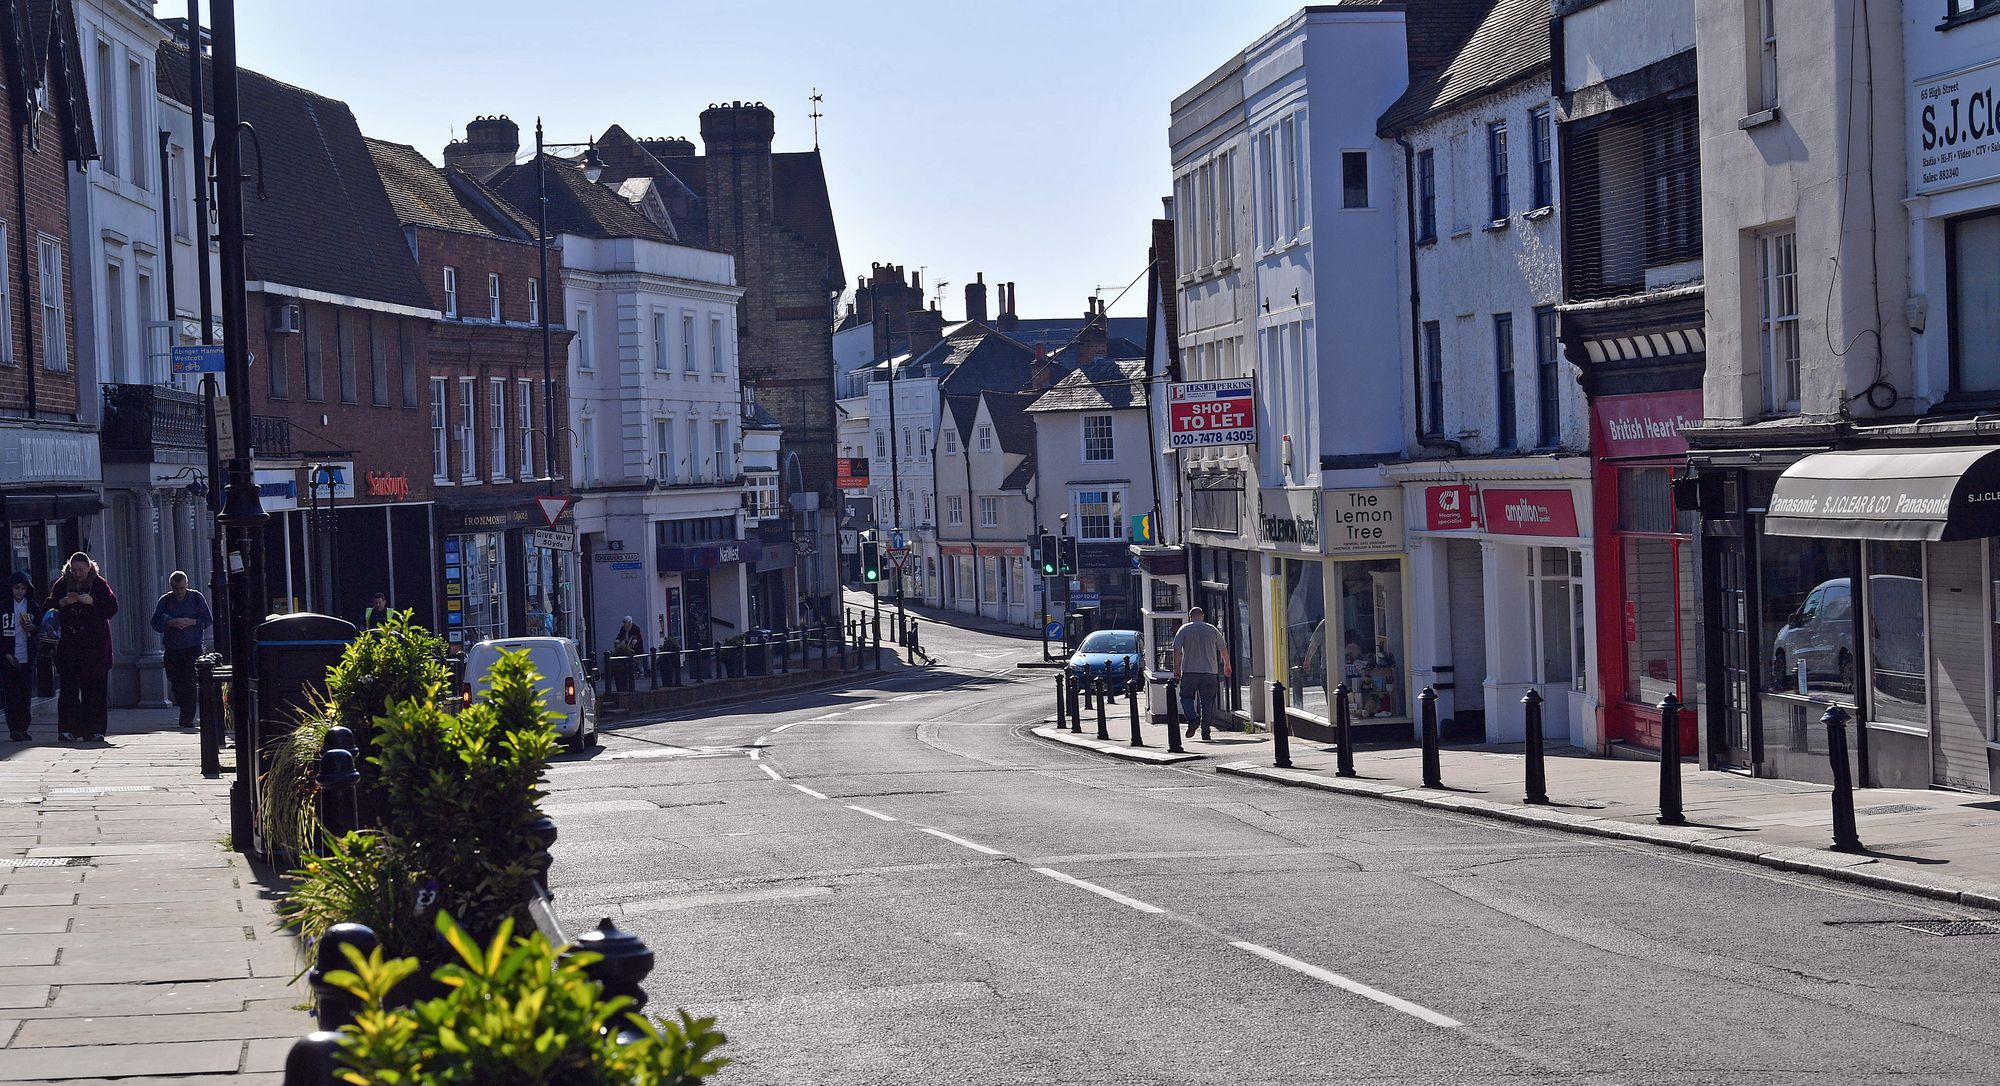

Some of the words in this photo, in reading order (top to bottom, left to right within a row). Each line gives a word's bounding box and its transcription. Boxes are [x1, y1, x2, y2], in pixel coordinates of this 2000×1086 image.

[1921, 89, 1928, 100] 65
[1929, 86, 1942, 99] High
[1942, 83, 1959, 95] Street
[1922, 156, 1937, 167] Radio
[1940, 151, 1953, 164] Hi-Fi
[1957, 148, 1971, 160] Video
[1975, 144, 1987, 156] CTV
[1923, 172, 1938, 184] Sales:
[1939, 167, 1959, 180] 883340
[1188, 383, 1216, 392] LESLIE
[1217, 381, 1252, 390] PERKINS
[1192, 402, 1232, 415] SHOP
[1180, 415, 1205, 430] TO
[1210, 413, 1245, 428] LET
[1609, 417, 1644, 441] British
[1644, 417, 1677, 438] Heart
[1226, 430, 1254, 442] 4305
[368, 471, 409, 500] Sainsbury's
[1349, 493, 1378, 507] The
[1769, 493, 1818, 513] Panasonic
[1822, 496, 1866, 514] S.J.CLEAR
[1866, 496, 1874, 513] &
[1874, 496, 1891, 513] CO
[1895, 494, 1949, 515] Panasonic
[1336, 510, 1392, 524] Lemon
[1505, 498, 1539, 529] amplifon
[536, 531, 555, 540] GIVE
[555, 533, 571, 542] WAY
[1347, 525, 1383, 539] Tree
[543, 539, 564, 548] 50yds
[719, 545, 740, 562] NatWest
